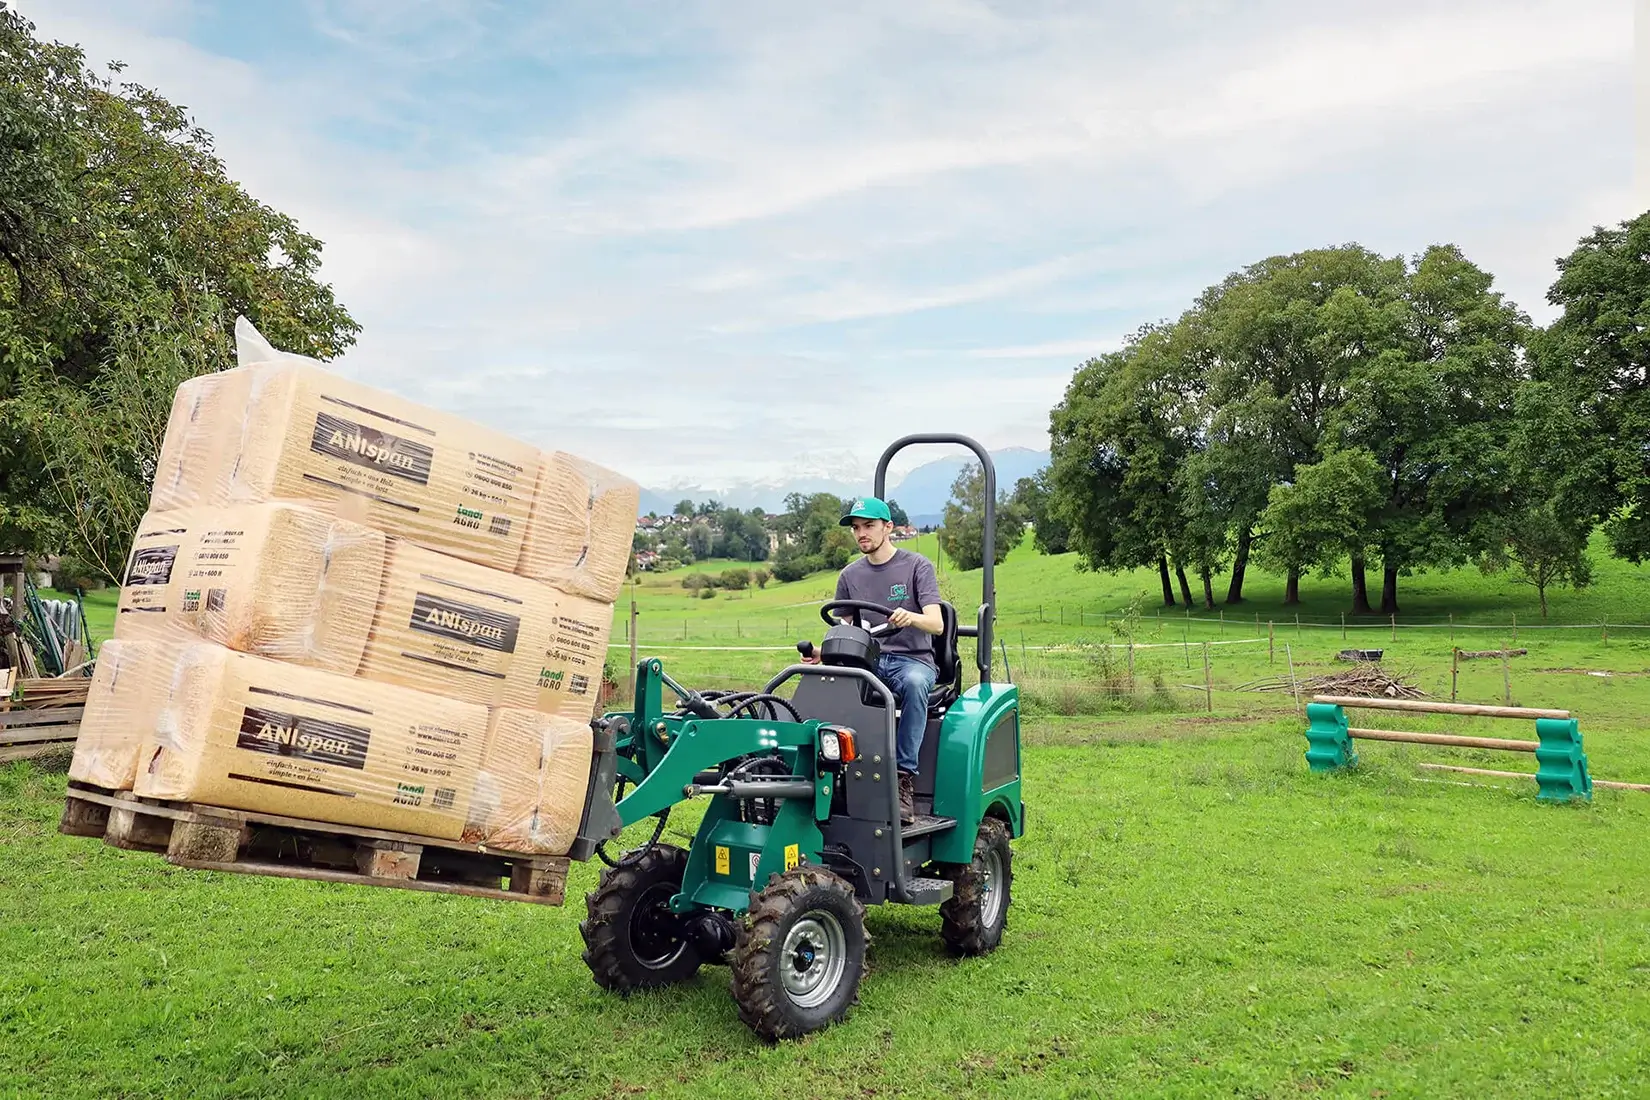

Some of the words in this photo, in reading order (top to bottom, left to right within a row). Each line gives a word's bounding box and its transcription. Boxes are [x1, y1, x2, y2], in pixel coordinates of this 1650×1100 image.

[329, 430, 414, 470] ANIspan
[425, 607, 502, 640] ANIspan
[536, 677, 561, 691] AGRO
[540, 666, 565, 681] Landi
[256, 721, 351, 756] ANIspan
[411, 764, 420, 772] 26
